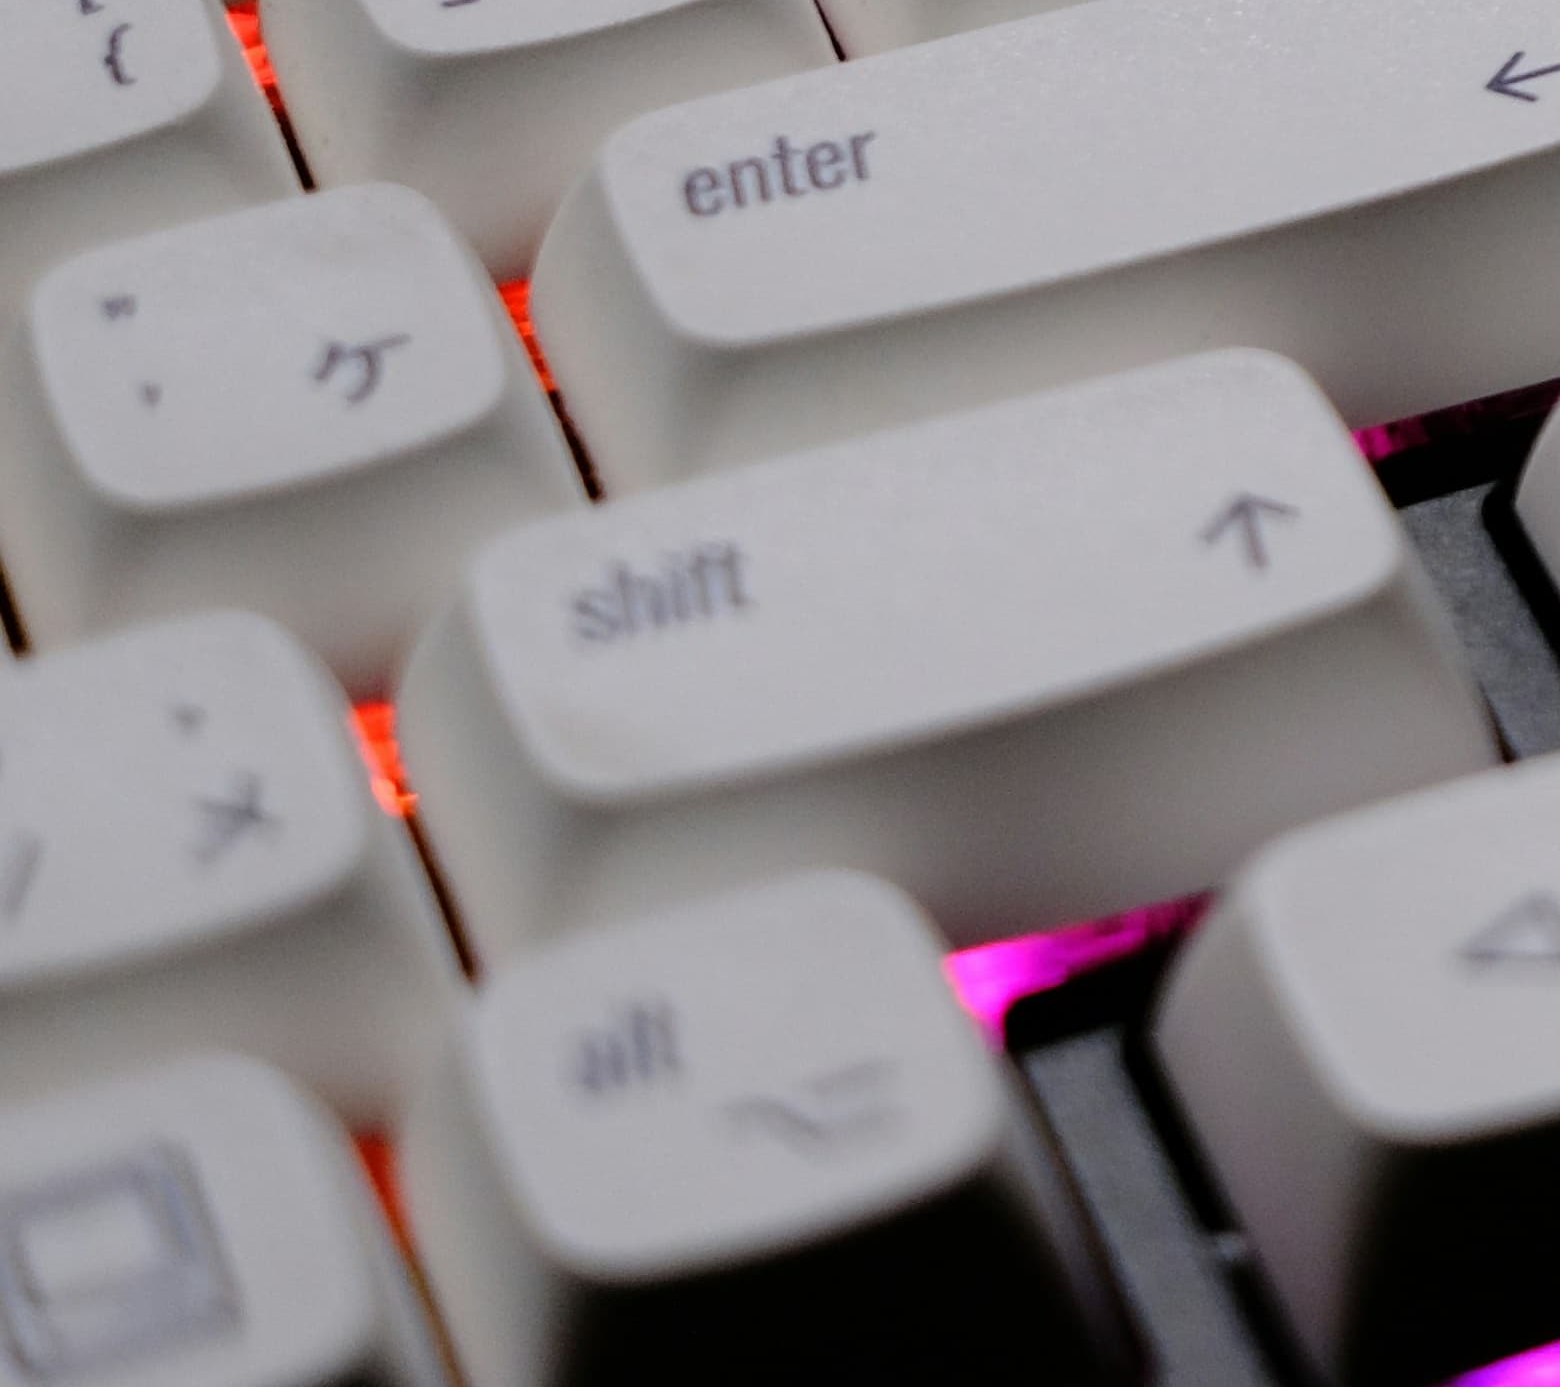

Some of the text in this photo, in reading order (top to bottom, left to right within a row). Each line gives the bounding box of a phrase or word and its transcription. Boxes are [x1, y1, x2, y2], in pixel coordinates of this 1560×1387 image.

[683, 131, 877, 218] enter
[573, 541, 750, 645] shift
[574, 1001, 682, 1097] alt
